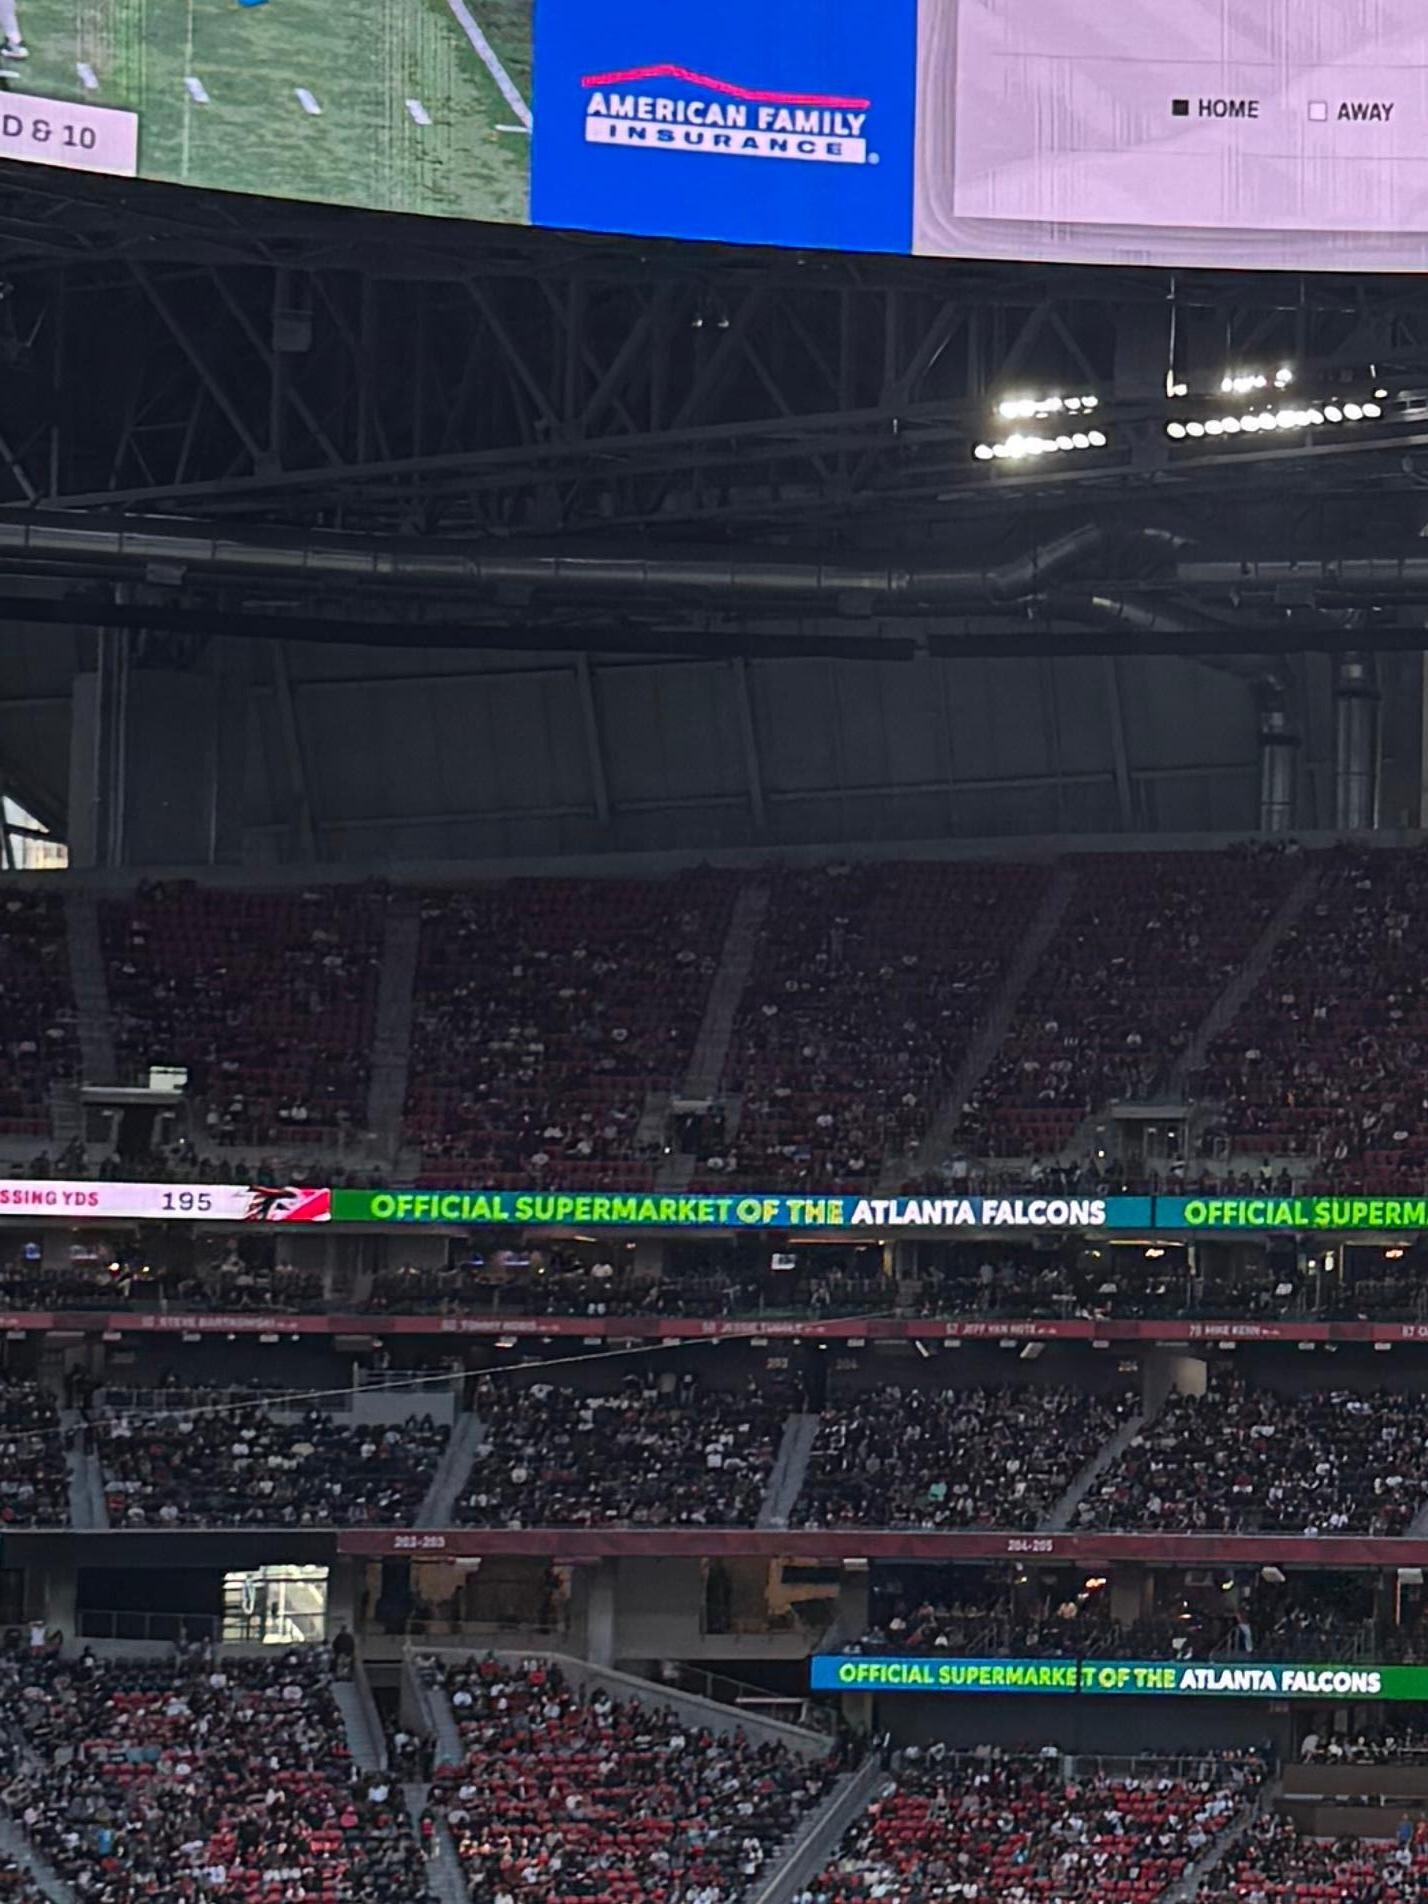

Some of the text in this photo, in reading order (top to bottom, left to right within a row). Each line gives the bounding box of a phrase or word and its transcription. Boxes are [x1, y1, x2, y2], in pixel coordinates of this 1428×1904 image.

[586, 93, 868, 137] AMERICAN FAMILY
[1198, 99, 1260, 119] HOME
[1336, 100, 1396, 123] AWAY
[608, 122, 846, 157] INSURANCE
[64, 1190, 99, 1208] YDS
[161, 1191, 213, 1212] 195
[371, 1194, 1106, 1225] OFFICIAL SUPERMARKET OF THE ATLANTA FALCONS
[838, 1663, 1380, 1693] OFFICIAL SUPERMARKET OF THE ATLANTA FALCONS
